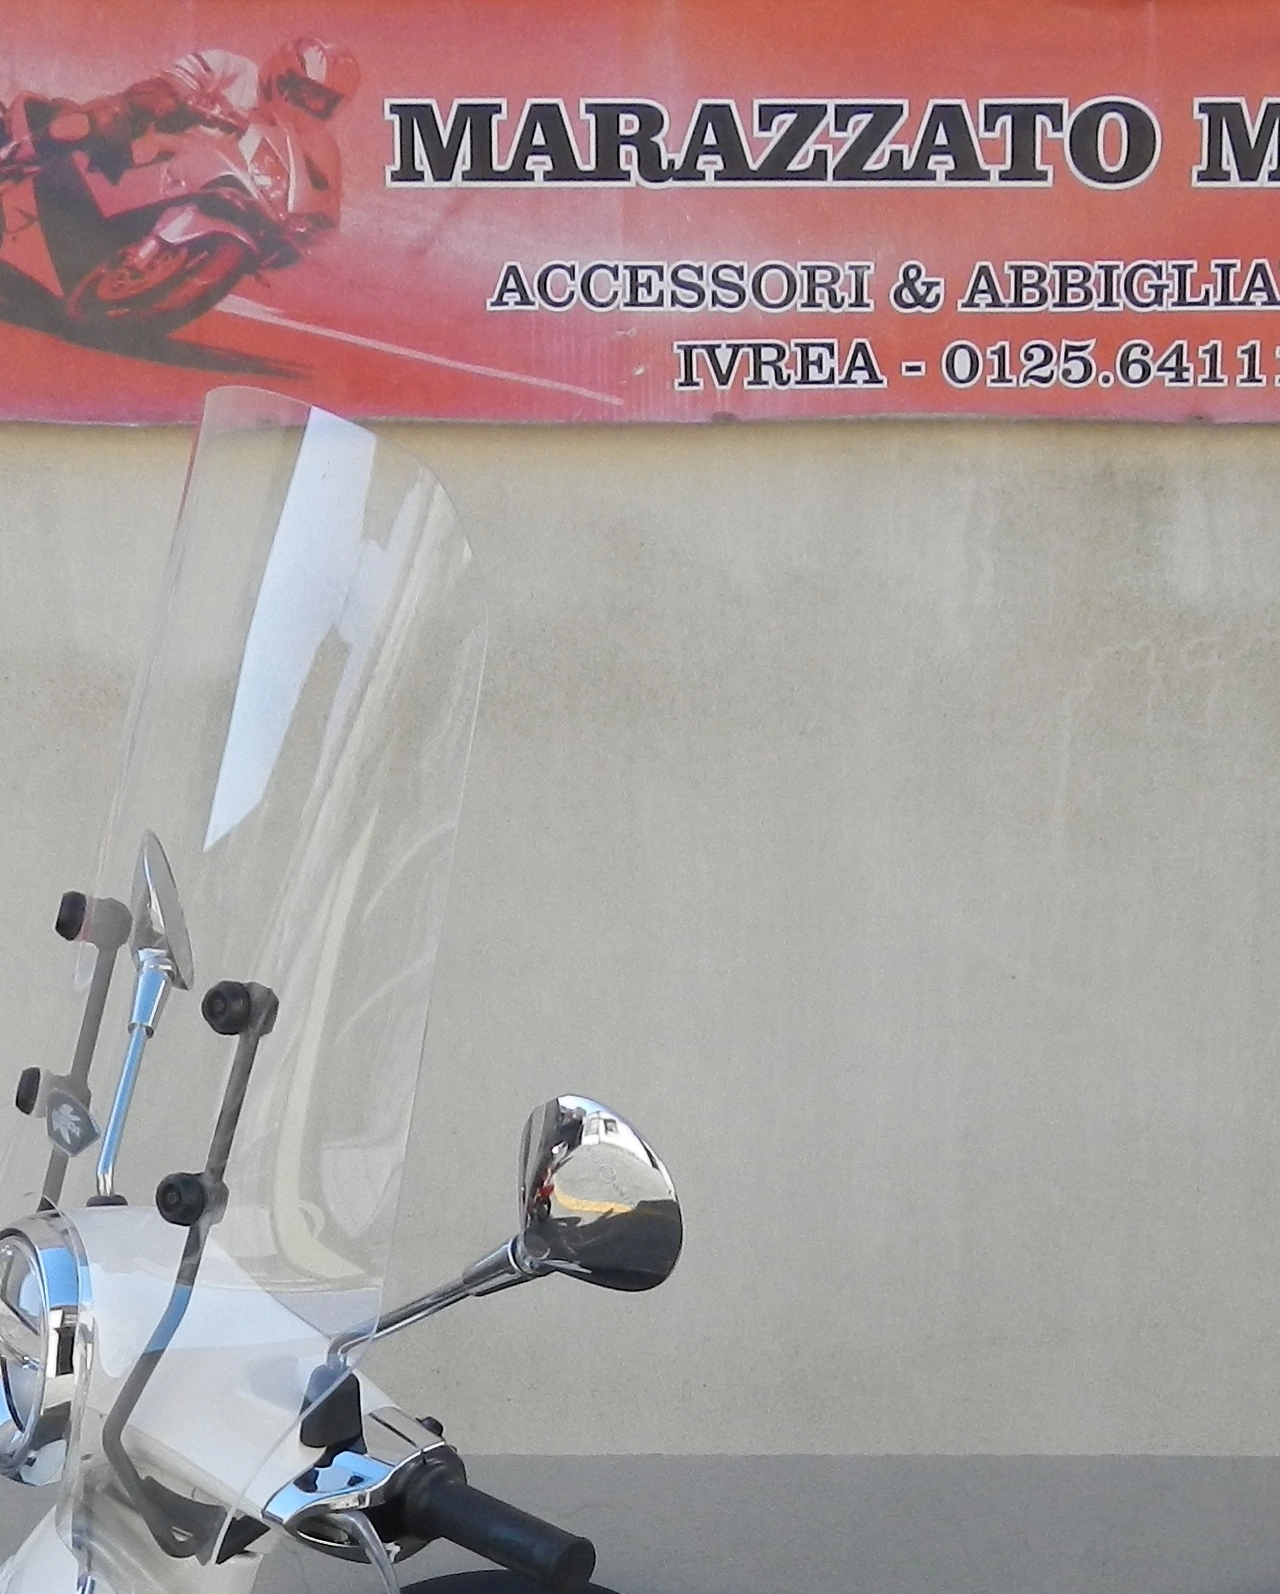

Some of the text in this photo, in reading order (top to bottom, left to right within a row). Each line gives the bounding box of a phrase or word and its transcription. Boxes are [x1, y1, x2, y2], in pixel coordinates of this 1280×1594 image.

[384, 96, 1162, 188] MARAZZATO
[487, 259, 875, 312] ACCESSORI
[890, 260, 943, 311] &
[674, 339, 889, 391] IVREA
